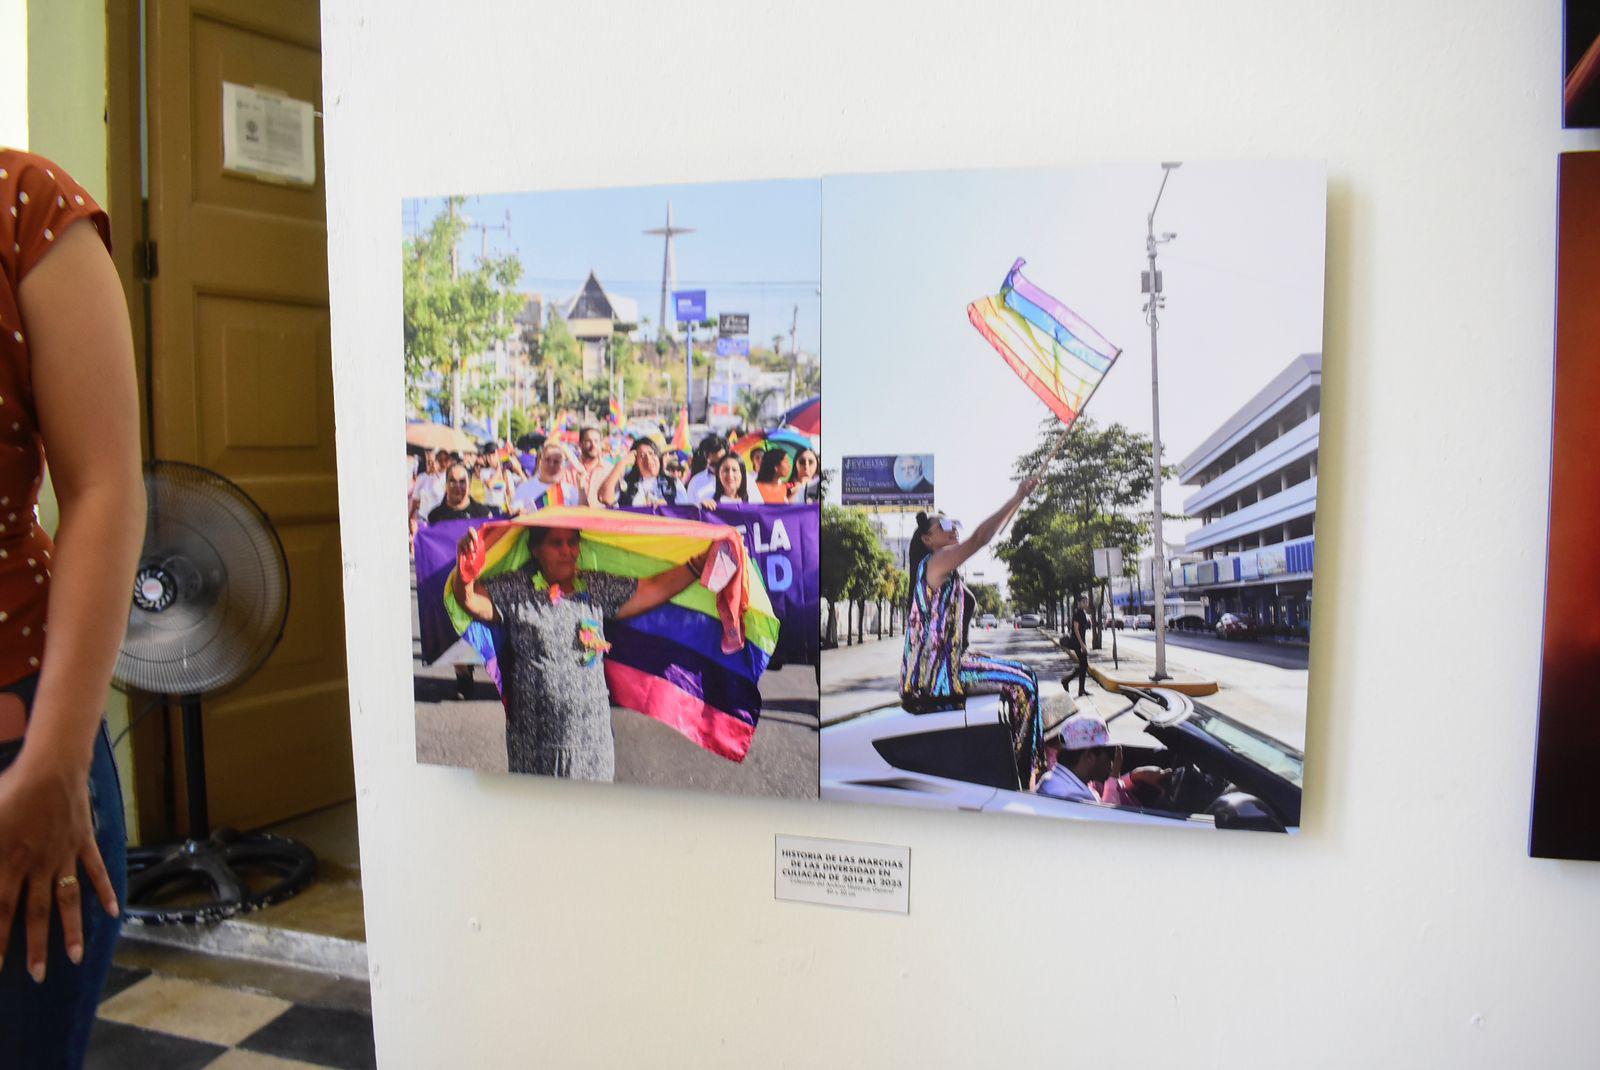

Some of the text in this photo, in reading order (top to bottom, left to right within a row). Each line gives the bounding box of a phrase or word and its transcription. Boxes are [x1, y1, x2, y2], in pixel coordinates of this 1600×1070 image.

[753, 518, 791, 553] LA
[757, 554, 793, 592] D
[781, 849, 903, 869] HISTORIA DE LAS MARCHAS
[790, 860, 891, 877] DE LAS DIVERSIDAD EN
[828, 872, 840, 881] DE
[842, 873, 864, 883] 2014
[866, 876, 877, 885] AL
